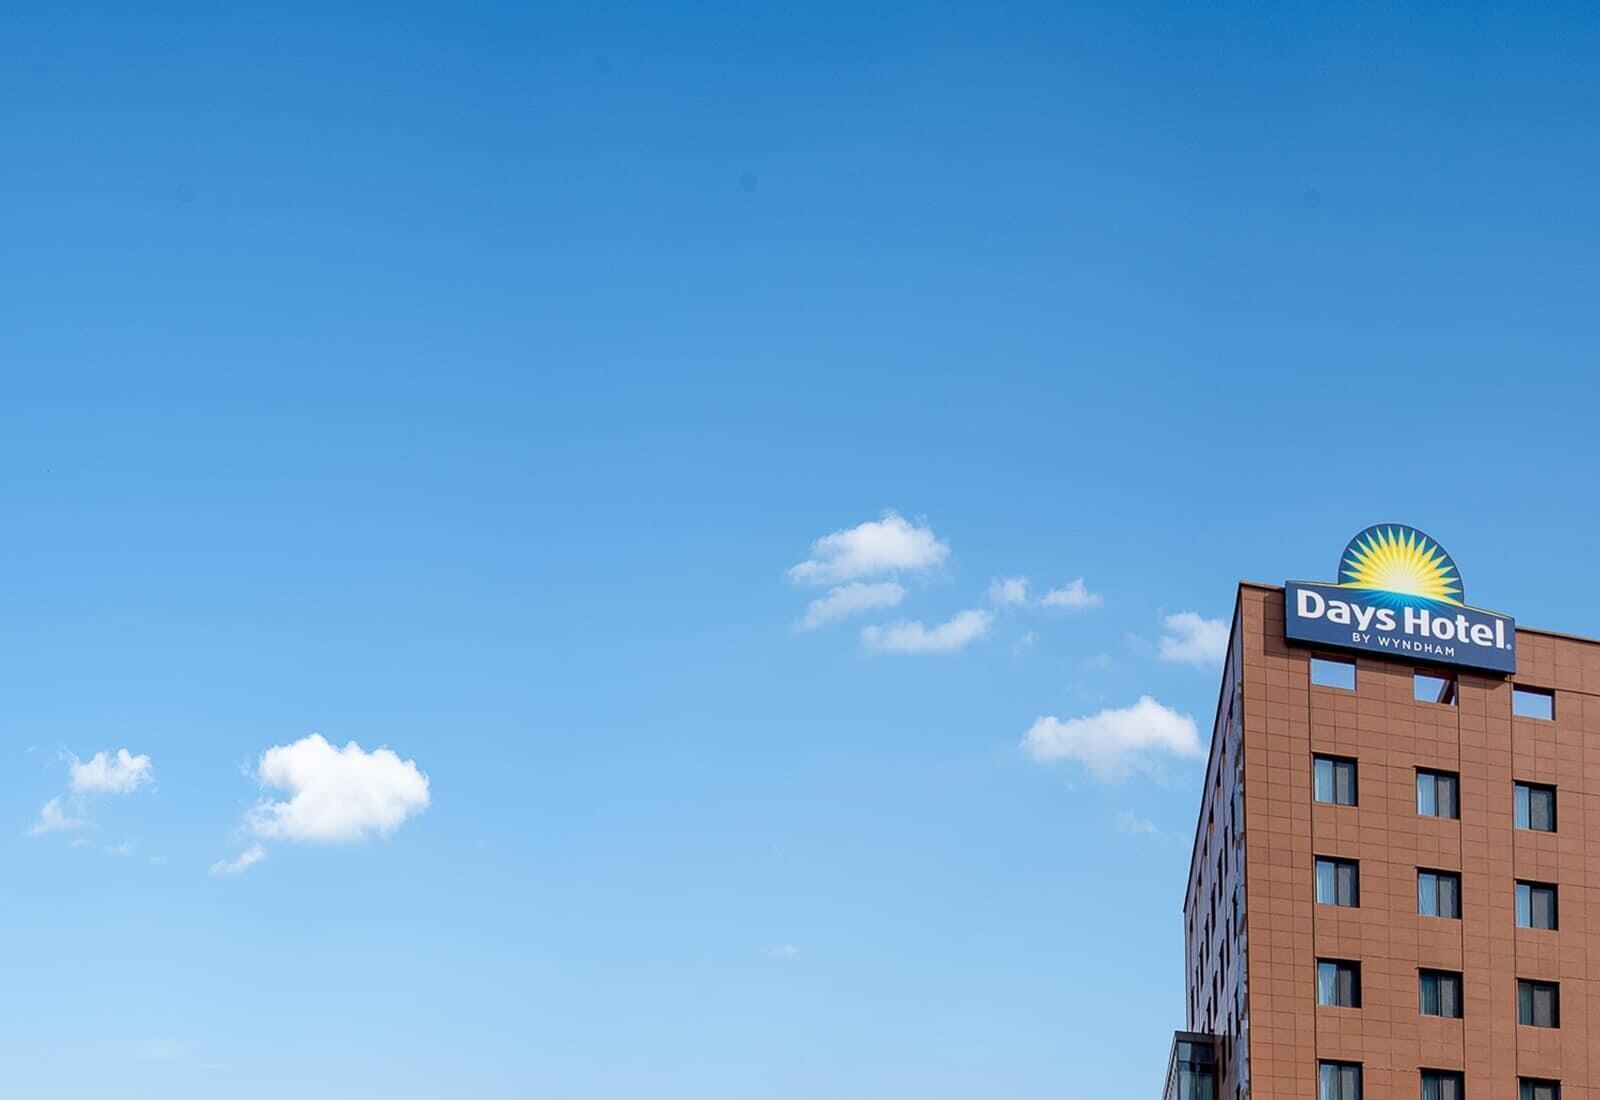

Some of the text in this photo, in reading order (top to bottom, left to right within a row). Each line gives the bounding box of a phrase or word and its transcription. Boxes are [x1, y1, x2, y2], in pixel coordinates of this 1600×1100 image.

[1296, 588, 1505, 649] Days Hotel
[1352, 632, 1455, 657] BY WYNDHAM
